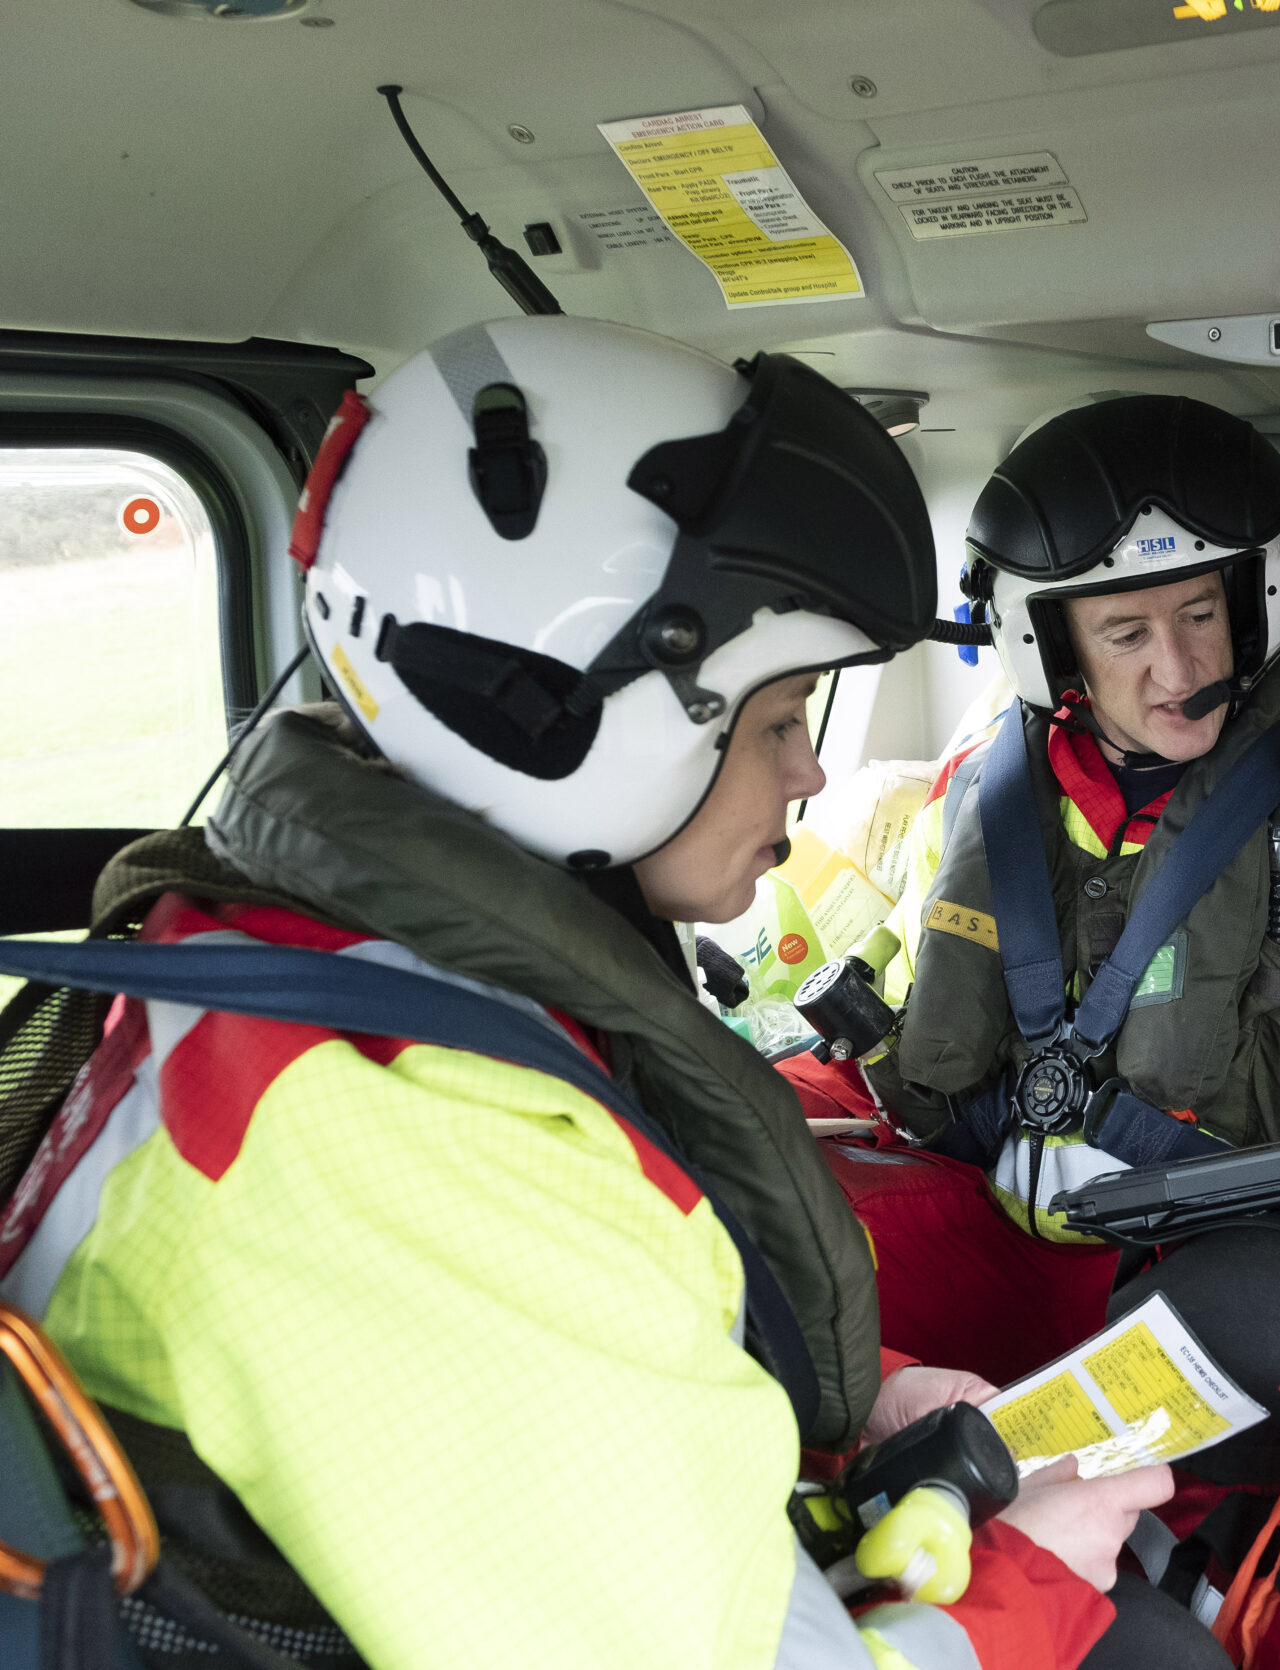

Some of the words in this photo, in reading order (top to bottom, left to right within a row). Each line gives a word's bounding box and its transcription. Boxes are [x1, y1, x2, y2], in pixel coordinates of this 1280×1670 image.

[891, 181, 913, 190] CHECK
[915, 178, 935, 187] PRIOR
[937, 177, 947, 185] TO
[950, 174, 967, 184] EACH
[969, 172, 991, 182] FLIGHT
[993, 170, 1007, 178] THE
[1010, 165, 1050, 177] ATTACHMENT
[951, 166, 979, 175] CAUTION
[926, 185, 946, 194] SEATS
[948, 183, 961, 191] AND
[963, 179, 1000, 190] STRETCHER
[1001, 175, 1037, 186] RETAINERS
[911, 209, 925, 217] FOR
[927, 205, 954, 216] TAKEOFF
[957, 204, 970, 212] AND
[972, 201, 999, 211] LANDING
[1002, 199, 1015, 207] THE
[1016, 197, 1033, 205] SEAT
[1035, 195, 1054, 204] MUST
[1056, 193, 1065, 201] BE
[914, 215, 939, 225] LOCKED
[950, 209, 984, 221] REARWARD
[986, 207, 1009, 217] FACING
[1010, 204, 1045, 215] DIRECTION
[1046, 202, 1057, 210] ON
[1059, 201, 1074, 210] THE
[939, 221, 968, 231] MARKING
[969, 219, 983, 228] AND
[994, 215, 1022, 226] UPRIGHT
[1024, 212, 1054, 222] POSITION
[1137, 537, 1175, 552] HSL
[781, 938, 798, 953] New
[1204, 1375, 1229, 1401] CHECKLIST
